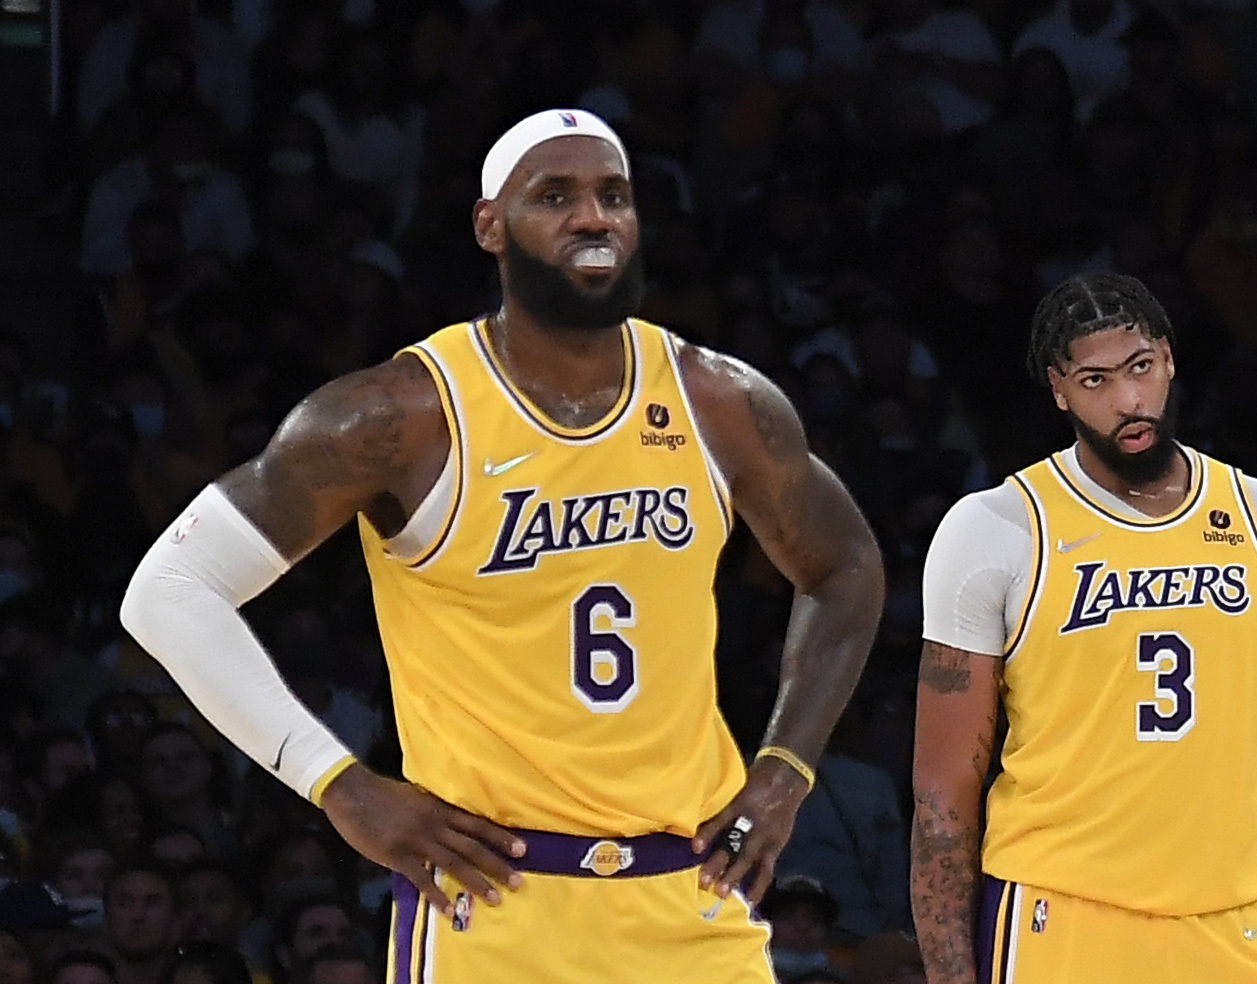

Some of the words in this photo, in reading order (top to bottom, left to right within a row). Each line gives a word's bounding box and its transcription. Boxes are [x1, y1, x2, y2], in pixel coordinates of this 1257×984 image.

[639, 431, 686, 451] bibigo
[476, 487, 694, 577] LAKERS
[1202, 530, 1245, 546] bibigo
[1059, 559, 1251, 636] LAKERS
[570, 582, 639, 713] 6
[1136, 631, 1195, 741] 3
